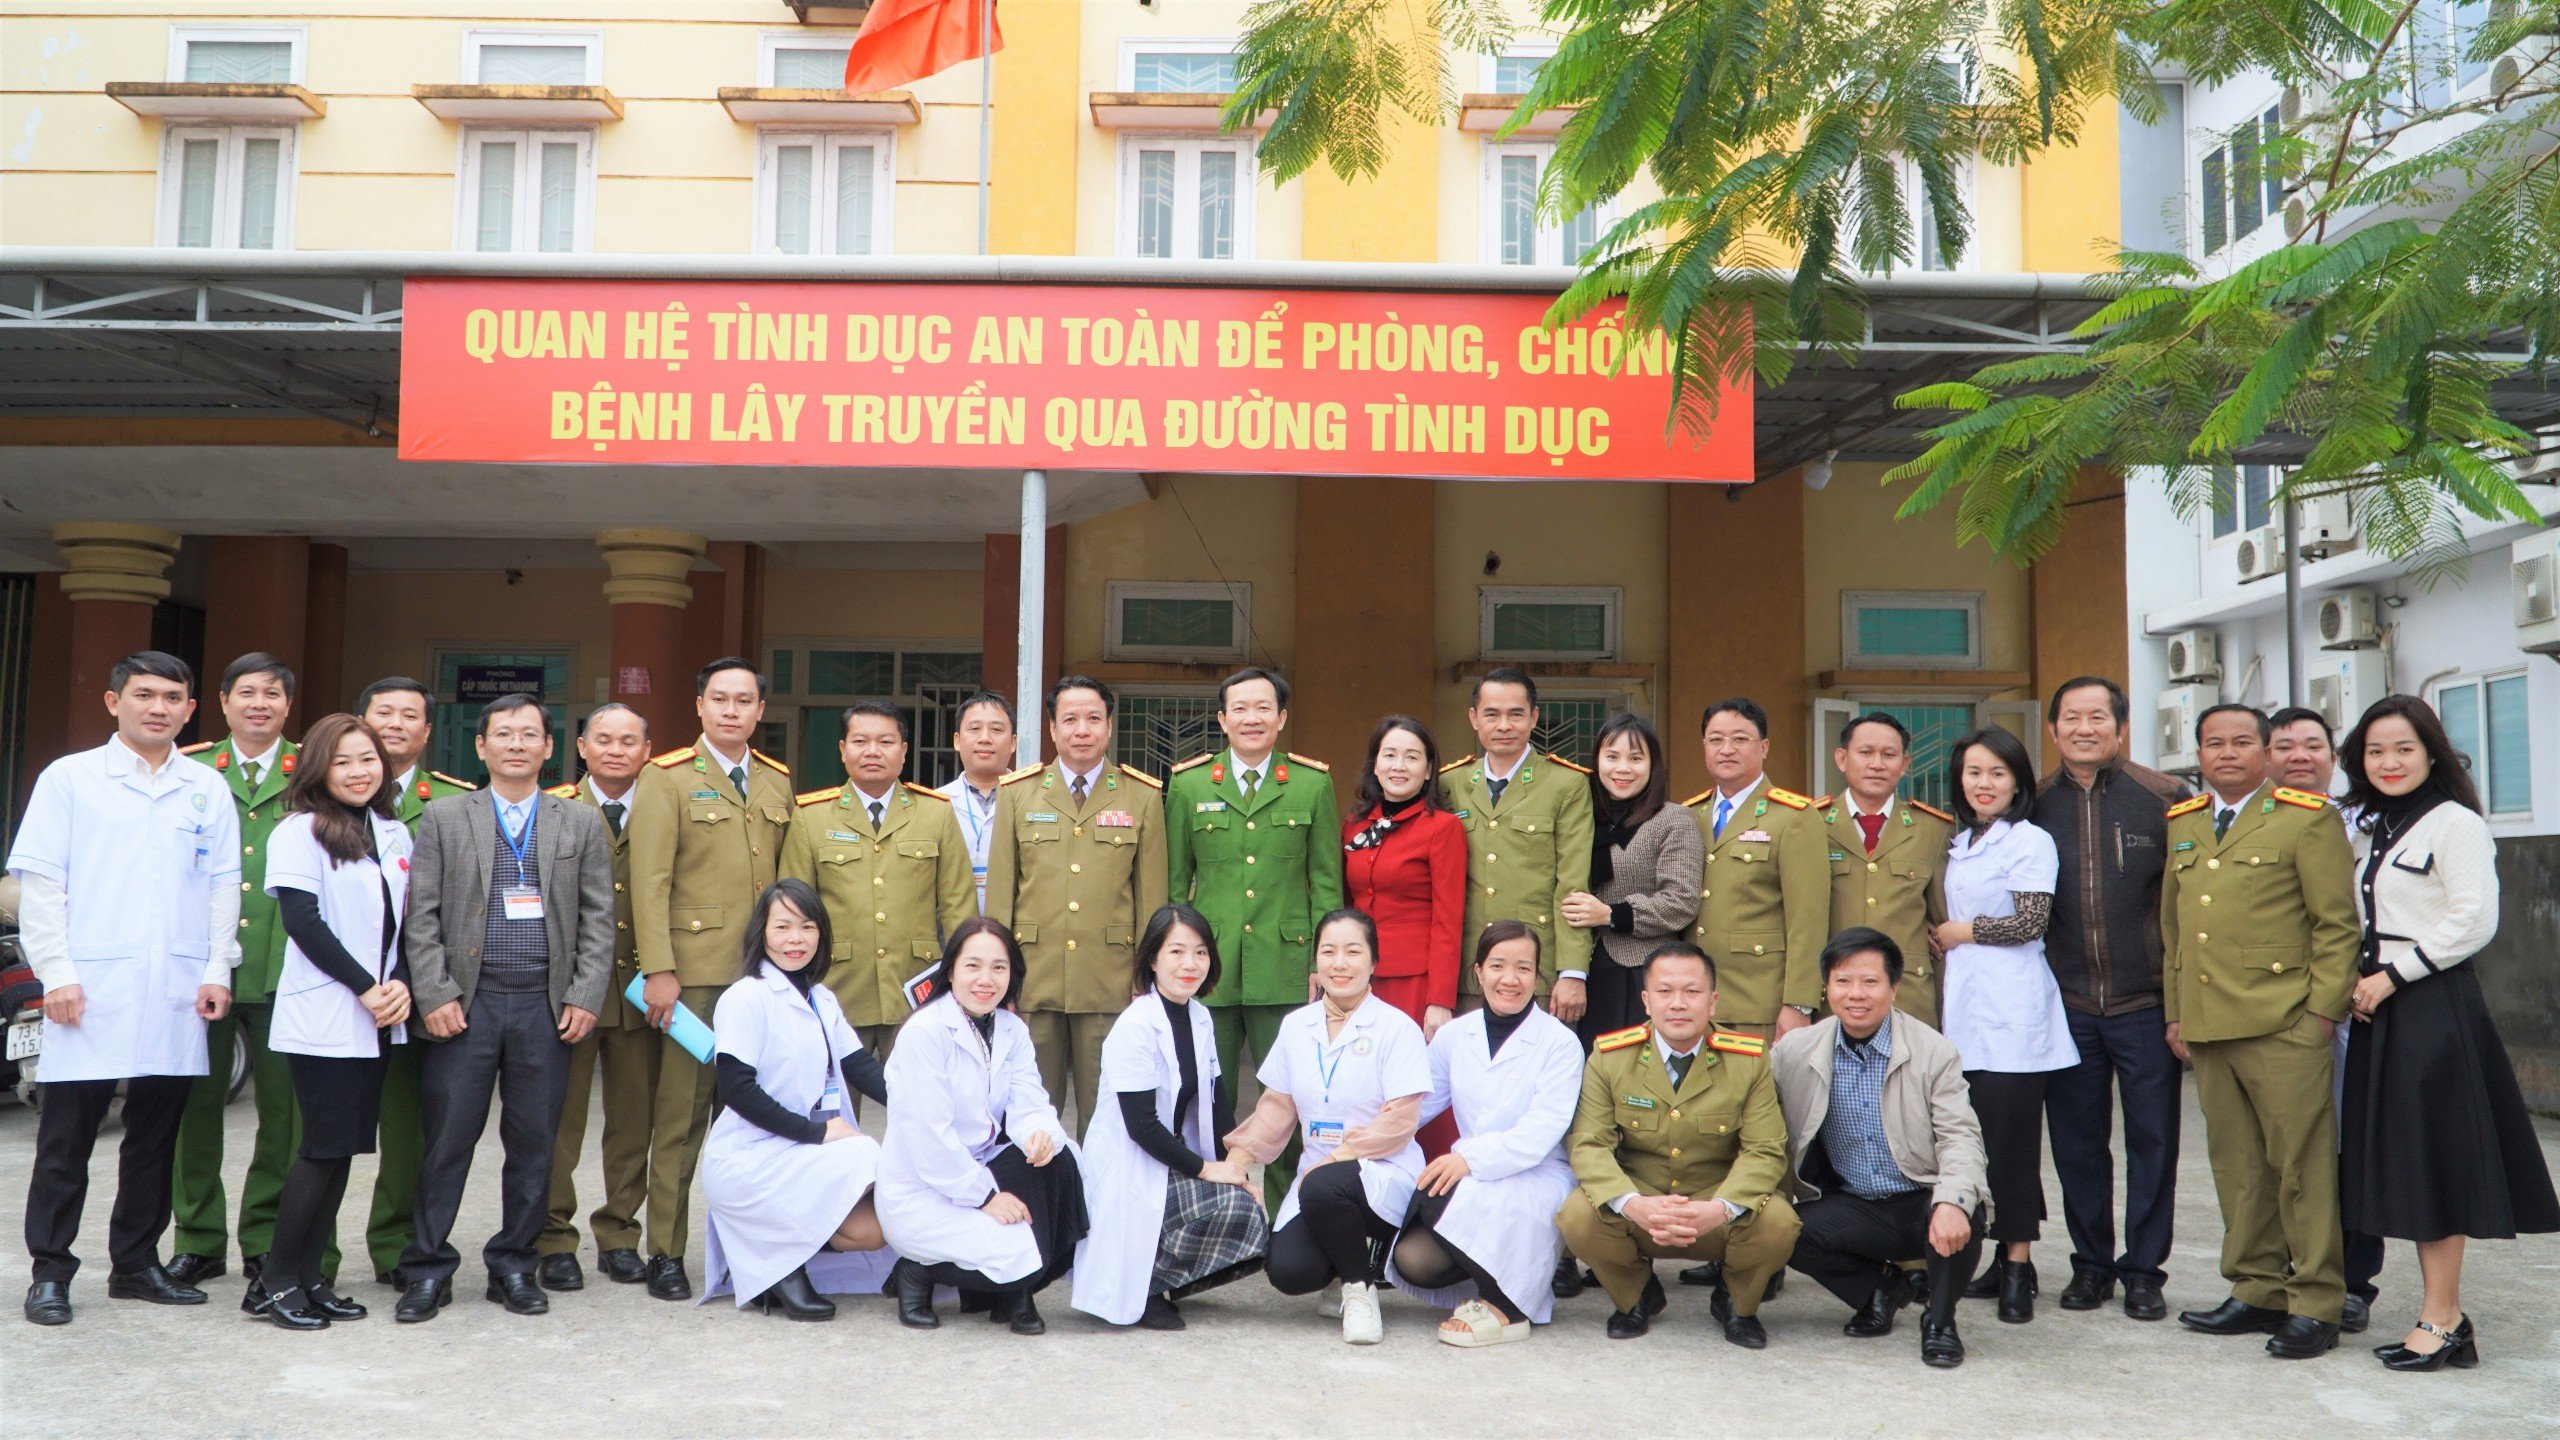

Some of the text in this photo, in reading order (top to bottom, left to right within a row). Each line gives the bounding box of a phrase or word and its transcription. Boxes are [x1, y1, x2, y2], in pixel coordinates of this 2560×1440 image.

[464, 308, 607, 364] QUAN
[623, 300, 691, 372] HỆ
[706, 301, 829, 363] TÌNH
[844, 313, 953, 376] DỤC
[967, 315, 1044, 367] AN
[1059, 307, 1201, 370] TOÀN
[1213, 301, 1289, 370] ĐỂ
[1302, 311, 1500, 380] PHÒNG,
[550, 379, 1611, 467] BỆNH LÂY TRUYỀN QUA ĐƯỜNG TÌNH DỤC
[13, 1037, 43, 1056] 115.
